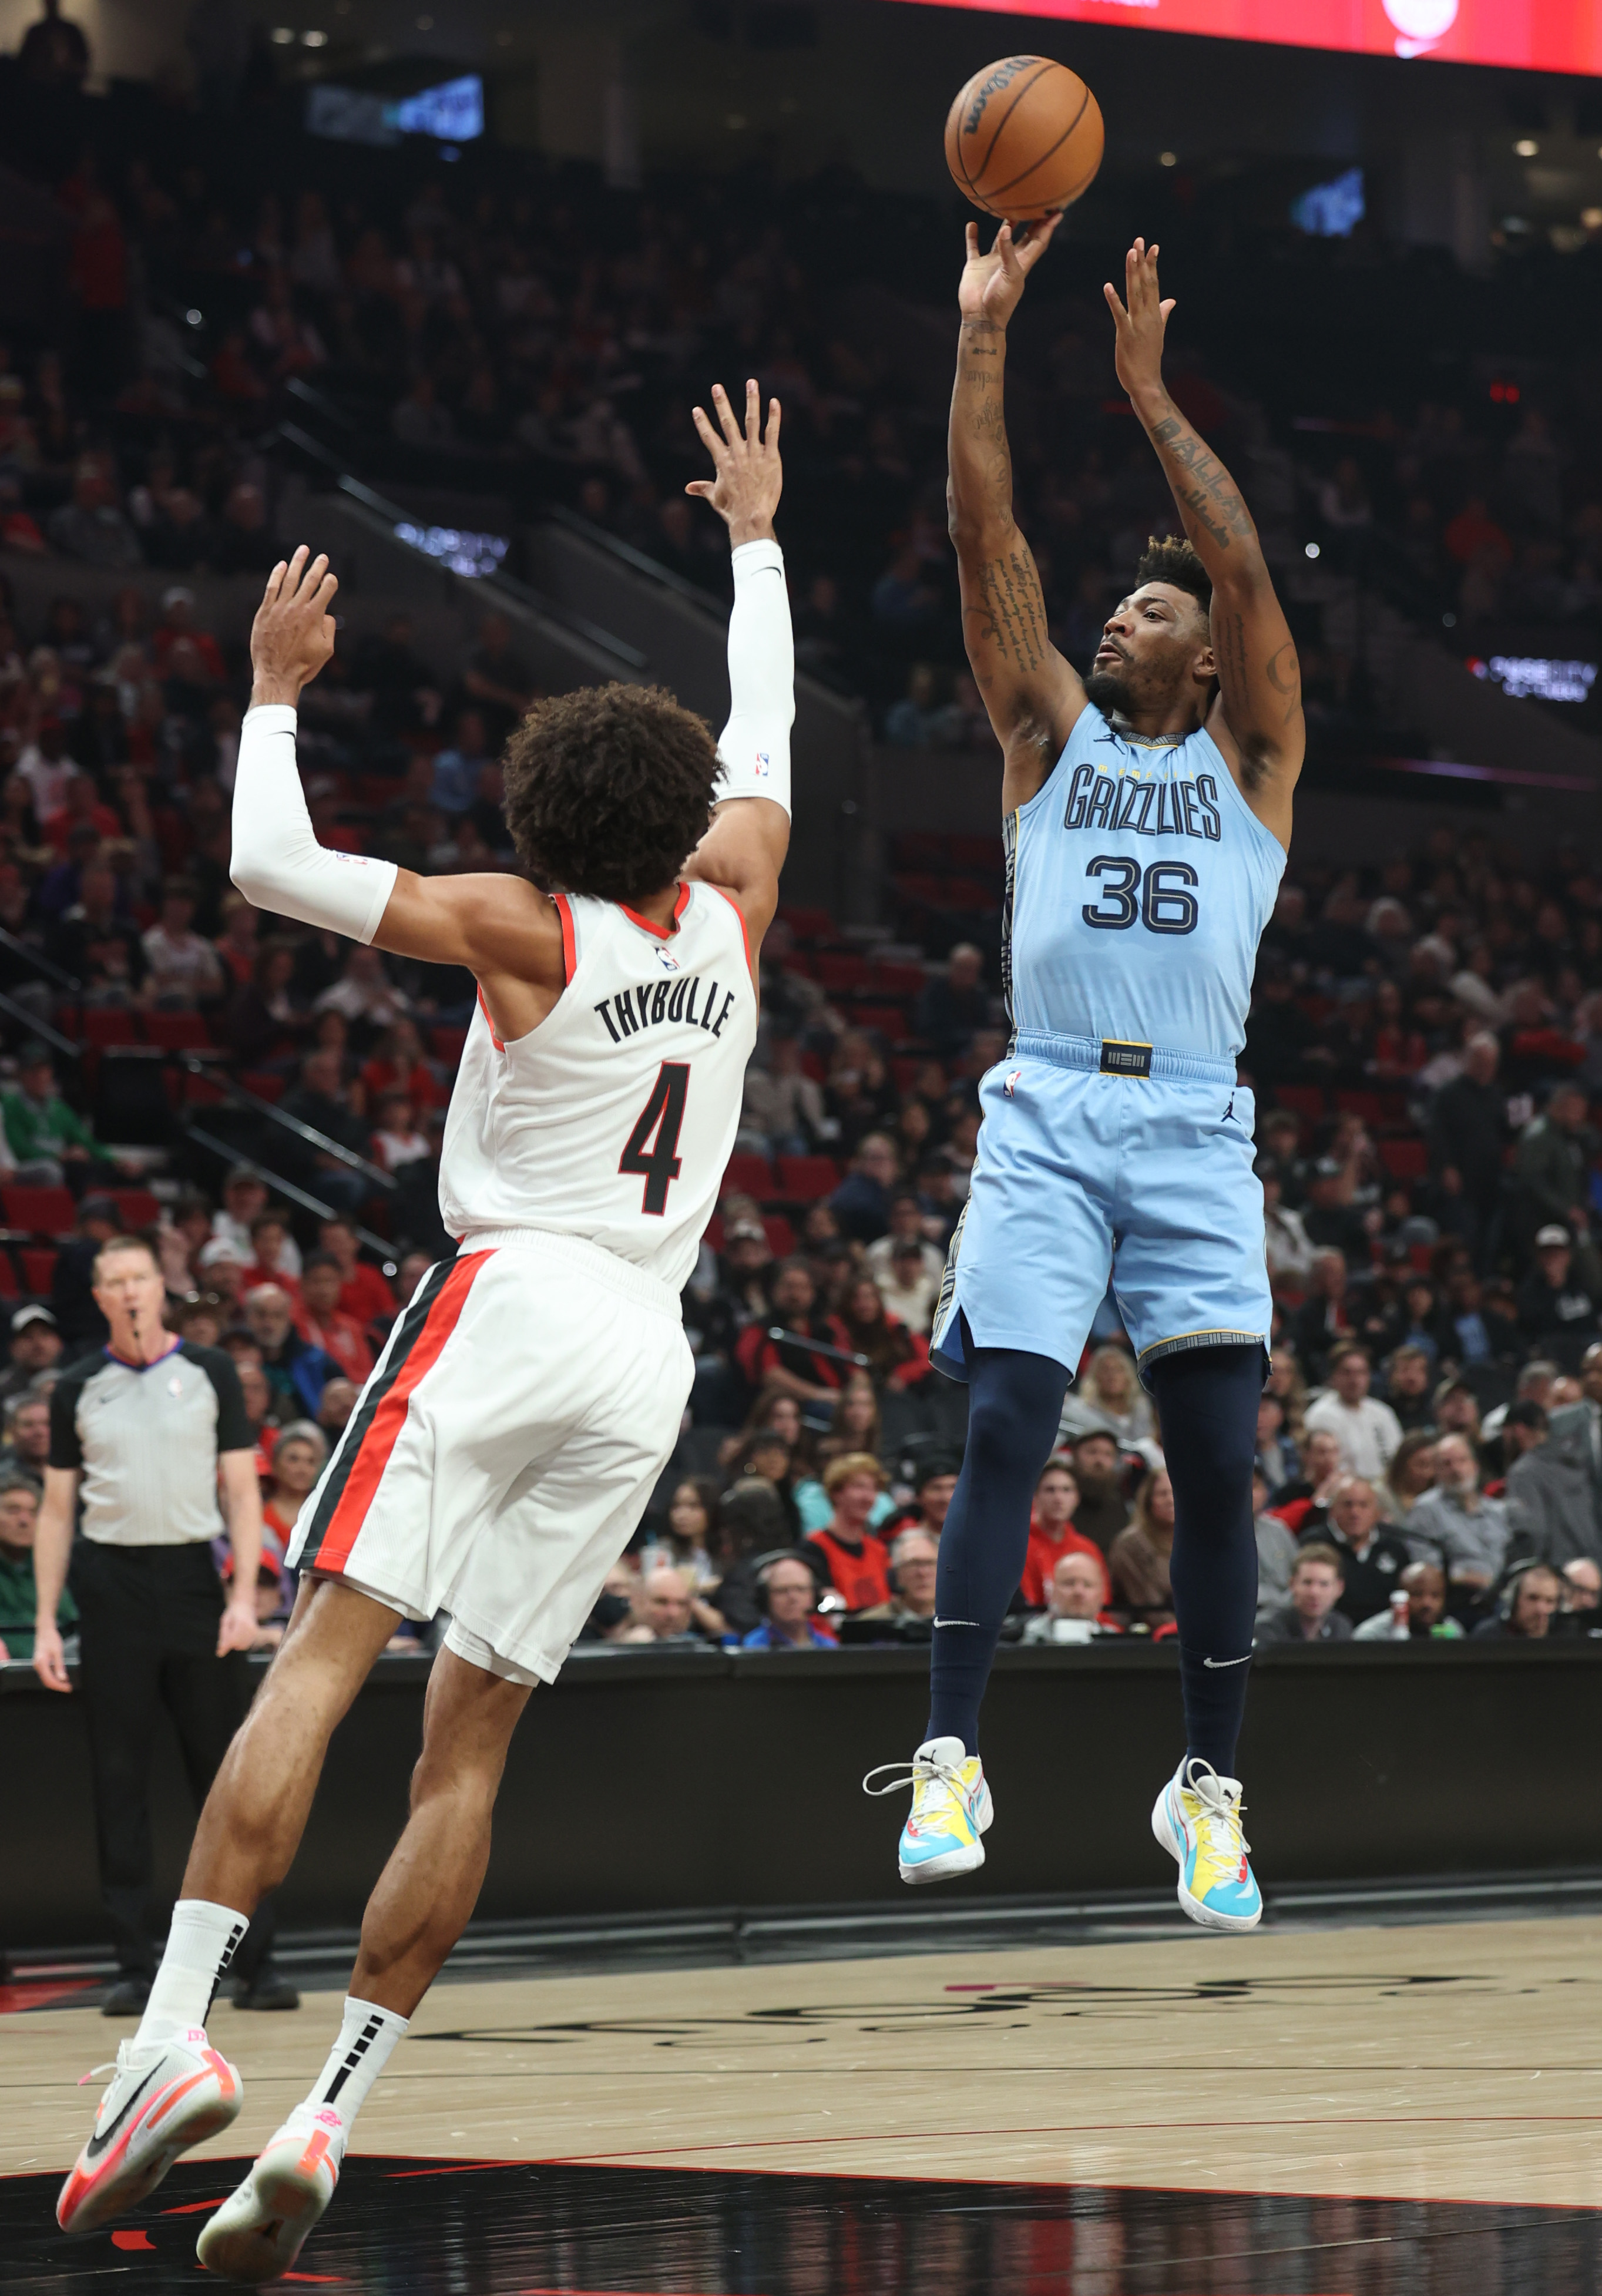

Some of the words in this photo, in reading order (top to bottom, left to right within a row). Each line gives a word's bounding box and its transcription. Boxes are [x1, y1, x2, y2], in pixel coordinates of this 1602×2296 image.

[1064, 763, 1221, 842] GRIZZLIES
[1082, 855, 1198, 935] 36
[593, 976, 735, 1043] THYBULLE
[617, 1060, 691, 1217] 4
